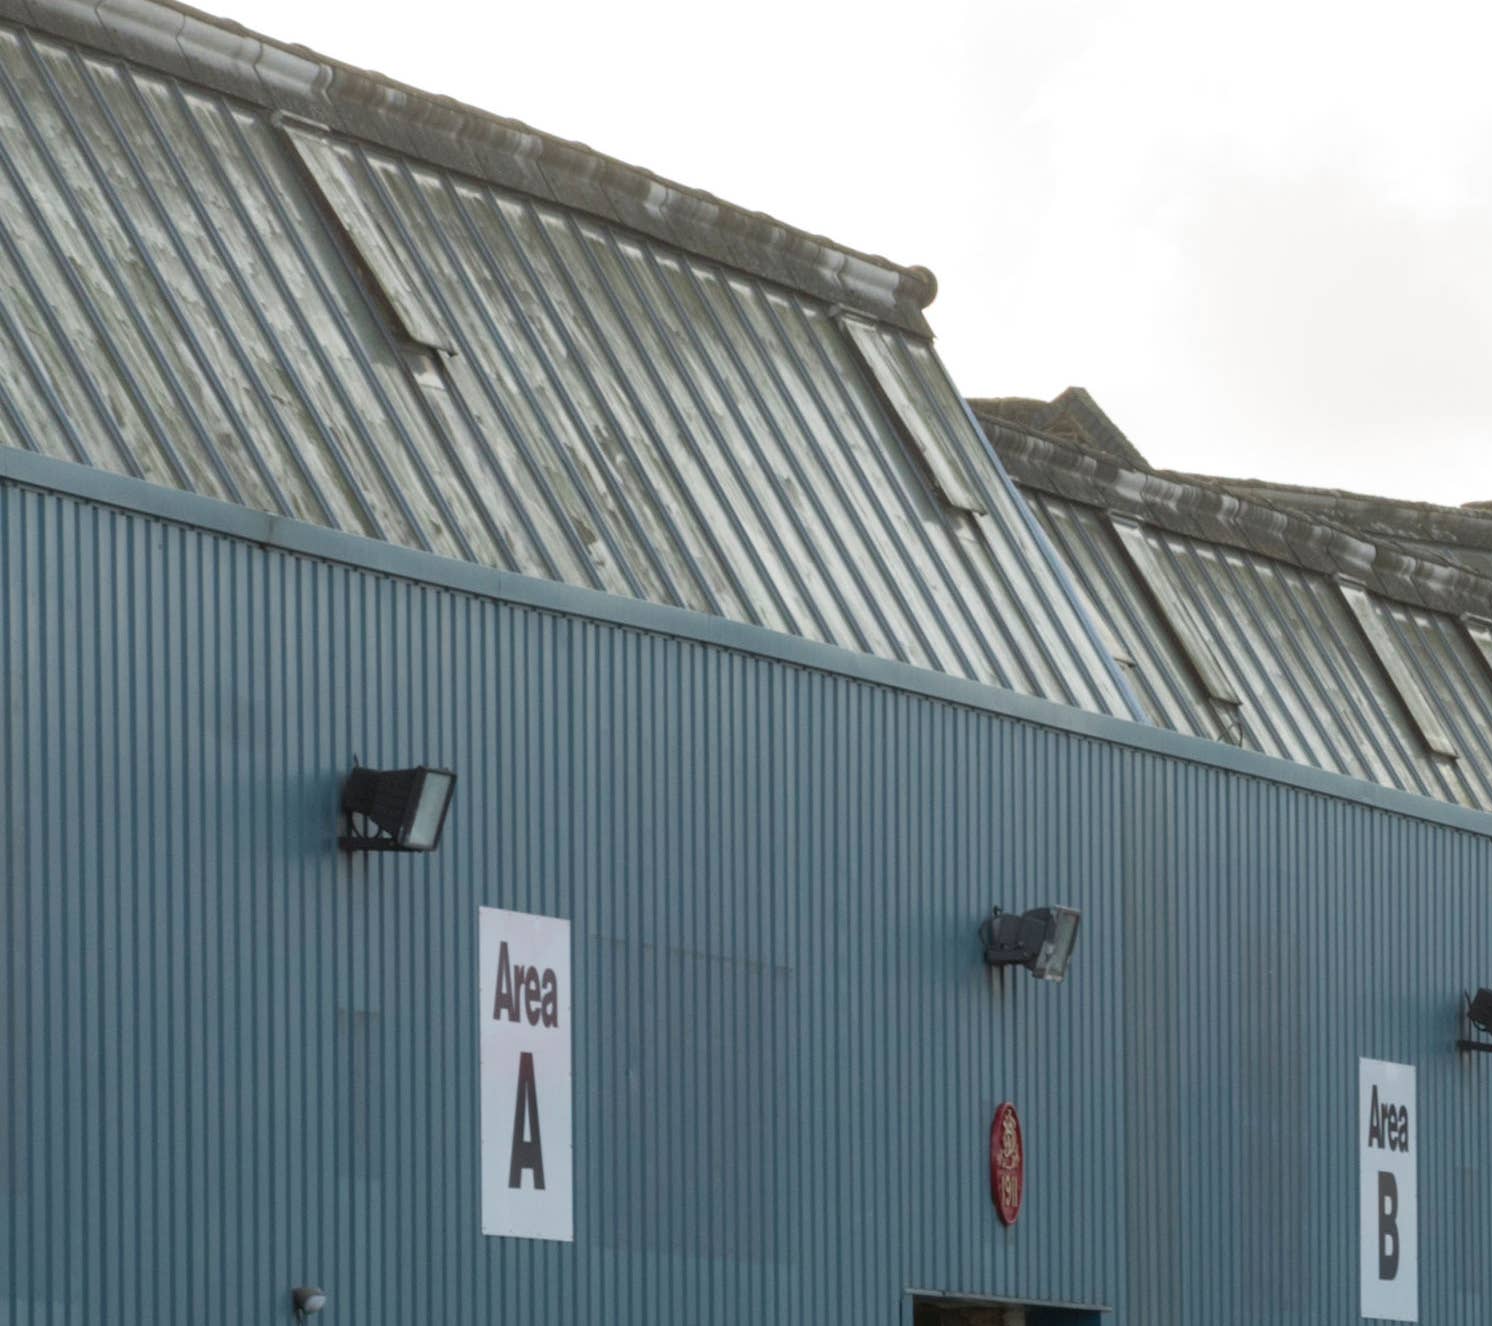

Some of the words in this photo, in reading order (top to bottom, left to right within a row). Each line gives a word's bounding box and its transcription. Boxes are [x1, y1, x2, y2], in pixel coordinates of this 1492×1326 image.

[493, 940, 559, 1028] Area
[508, 1051, 546, 1190] A
[1368, 1084, 1410, 1153] Area
[1378, 1170, 1400, 1281] B
